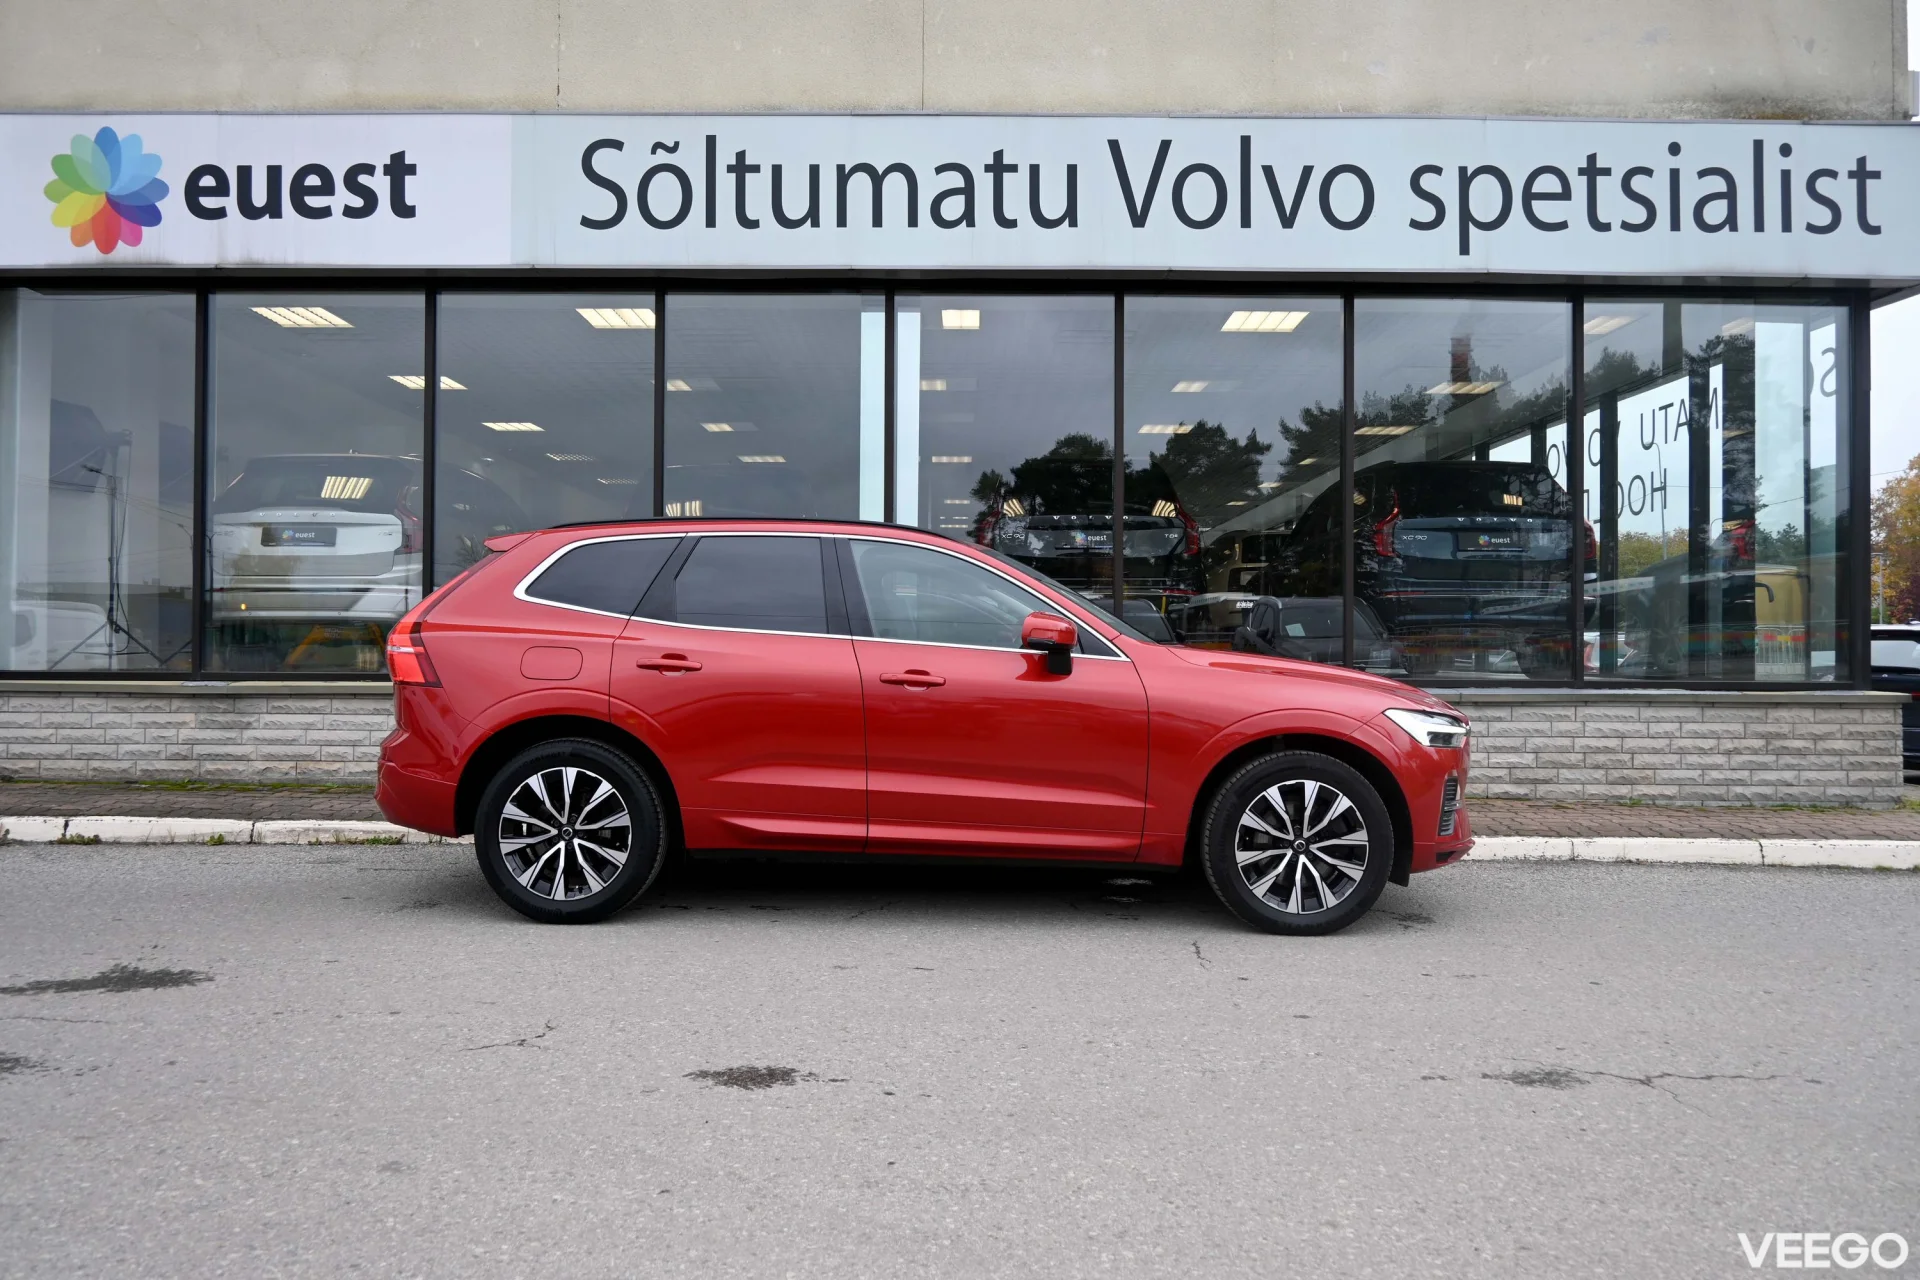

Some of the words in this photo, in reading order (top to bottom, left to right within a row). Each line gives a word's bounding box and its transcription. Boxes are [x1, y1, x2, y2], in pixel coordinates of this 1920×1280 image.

[184, 150, 417, 221] euest
[579, 134, 1078, 231] Sõltumatu
[1107, 135, 1375, 231] Volvo
[1408, 138, 1883, 256] spetsialist
